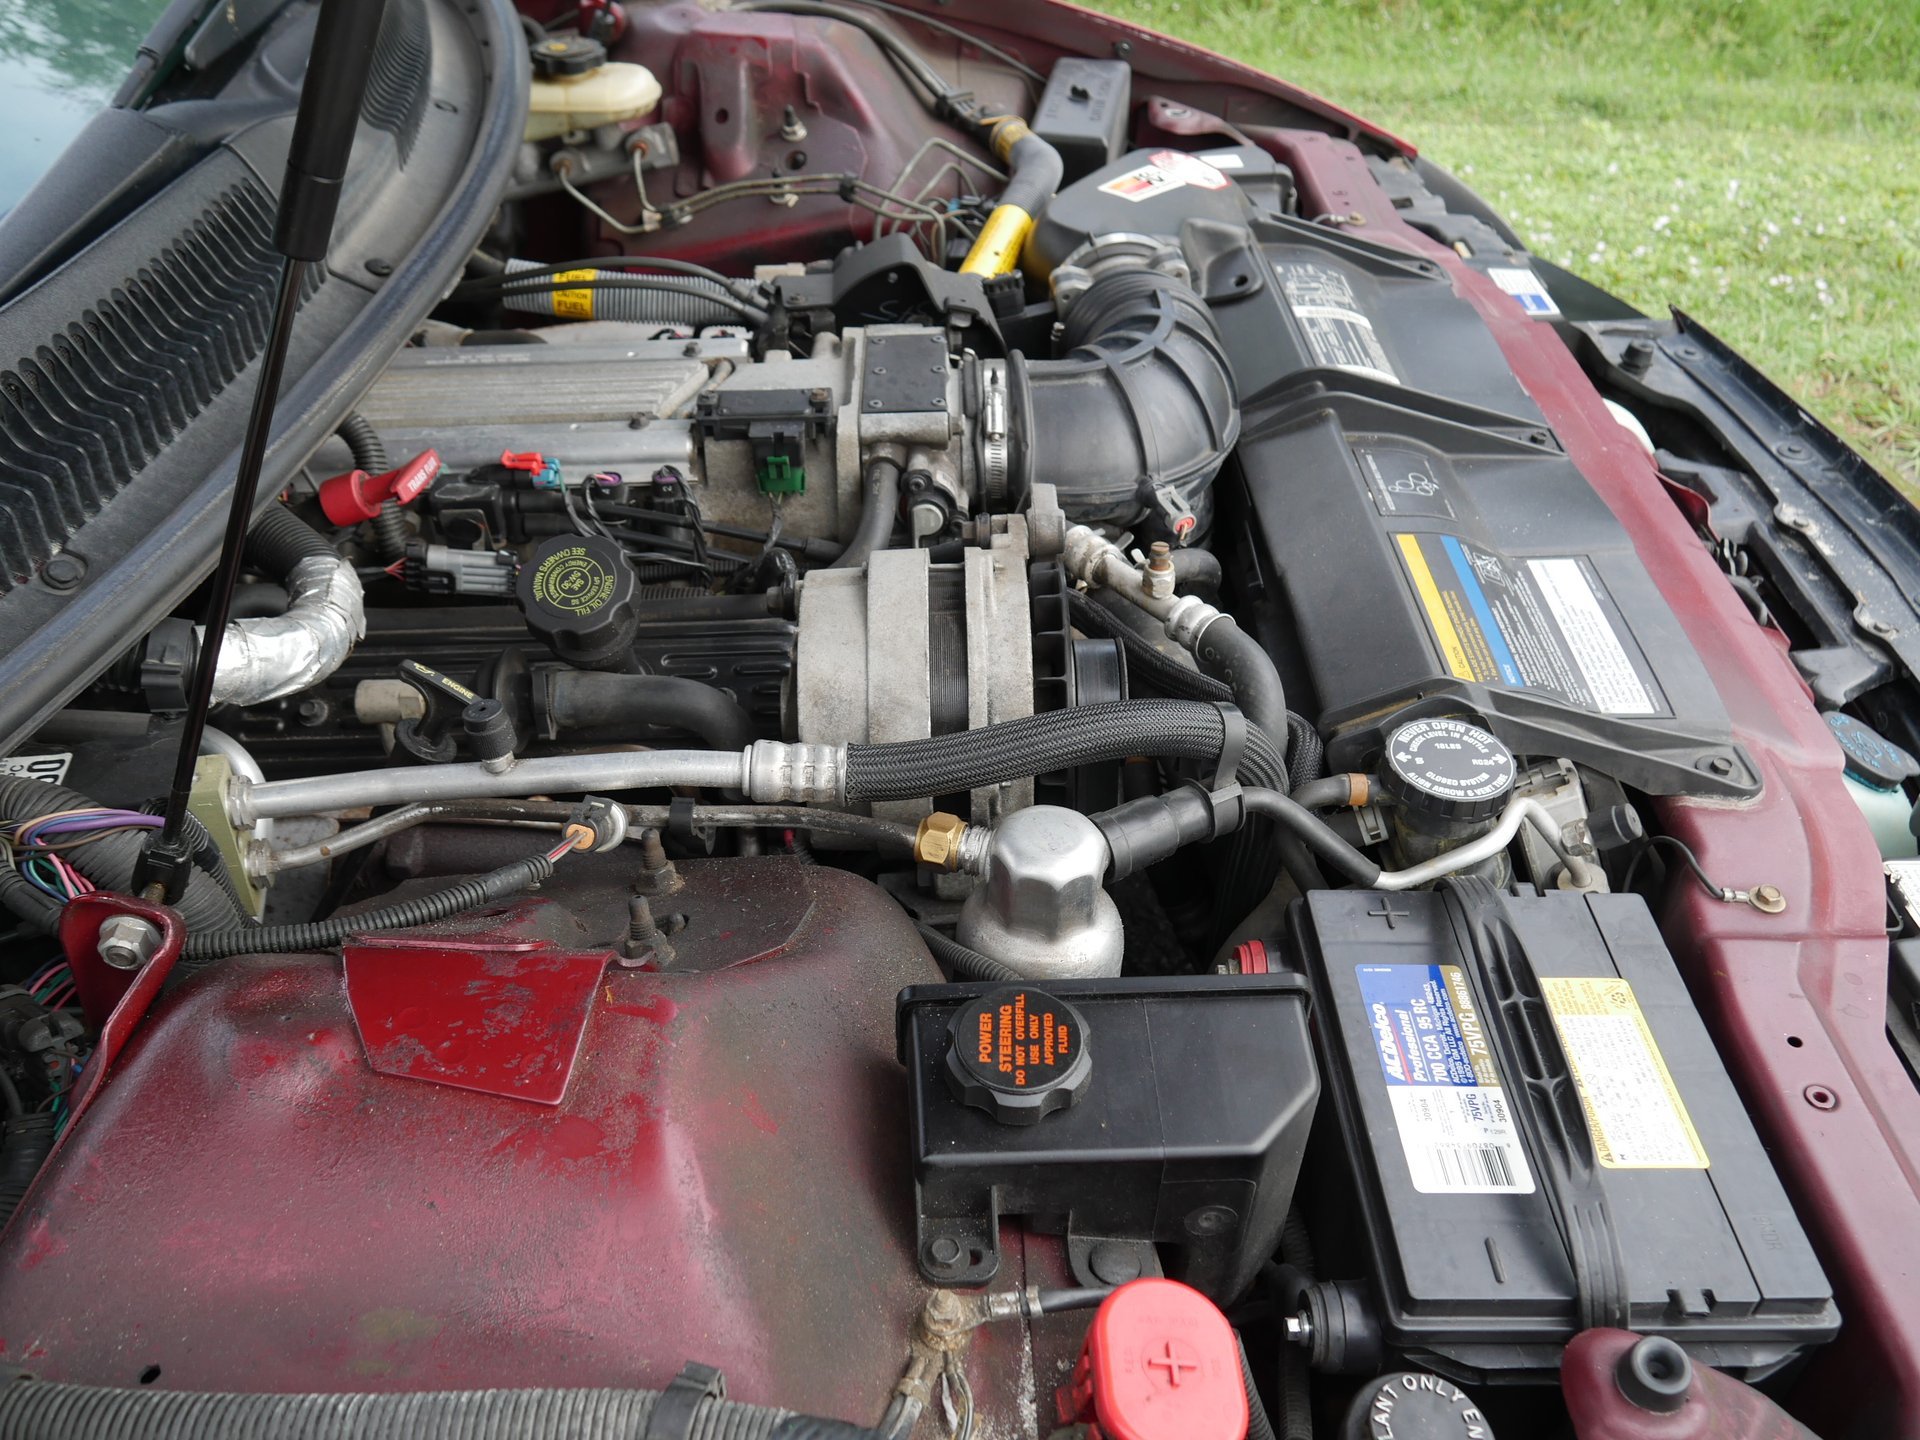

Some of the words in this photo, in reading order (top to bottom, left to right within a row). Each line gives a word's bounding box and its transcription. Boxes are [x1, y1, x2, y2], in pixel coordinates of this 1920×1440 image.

[558, 302, 587, 311] FUEL
[408, 469, 427, 492] TRANS
[572, 547, 586, 555] SEE
[533, 572, 544, 602] MANUAL
[561, 570, 581, 590] 5W-30
[570, 578, 585, 591] SAE
[600, 575, 614, 600] ENGINE
[575, 607, 591, 616] FILL
[590, 600, 603, 610] OIL
[442, 678, 474, 699] ENGINE
[1397, 723, 1429, 743] NEVER
[1431, 722, 1466, 733] OPEN
[1469, 729, 1493, 745] HOT
[1410, 736, 1426, 752] CHECK
[1425, 731, 1449, 740] LEVEL
[1462, 736, 1489, 754] BOTTLE
[1407, 772, 1431, 789] ALIGN
[1432, 785, 1465, 796] ARROW
[1474, 785, 1496, 796] VENT
[1426, 771, 1458, 786] CLOSED
[1459, 772, 1490, 786] SYSTEM
[1015, 994, 1026, 1040] OVERFILL
[1410, 999, 1427, 1013] RC
[1428, 1005, 1445, 1030] Michigan
[1438, 1007, 1449, 1026] Rights
[1440, 988, 1460, 1037] www.acdelco.com
[1029, 1014, 1040, 1039] ONLY
[1416, 1016, 1432, 1029] 95
[1458, 1012, 1486, 1054] 75VPG
[979, 1013, 992, 1063] POWER
[999, 1004, 1013, 1073] STEERING
[1044, 1013, 1054, 1065] APPROVED
[1058, 1025, 1068, 1054] FLUID
[1373, 1004, 1404, 1079] ACDelco
[1395, 1010, 1426, 1081] Professional
[1422, 1035, 1441, 1059] CCA
[1446, 1036, 1456, 1047] LLC
[1015, 1044, 1026, 1066] NOT
[1030, 1044, 1040, 1065] USE
[1450, 1048, 1460, 1059] GM
[1016, 1070, 1026, 1085] DO
[1430, 1062, 1449, 1081] 700
[1465, 1093, 1483, 1120] 75VPG
[1492, 1099, 1506, 1122] 30904
[1402, 1375, 1466, 1403] ONLY
